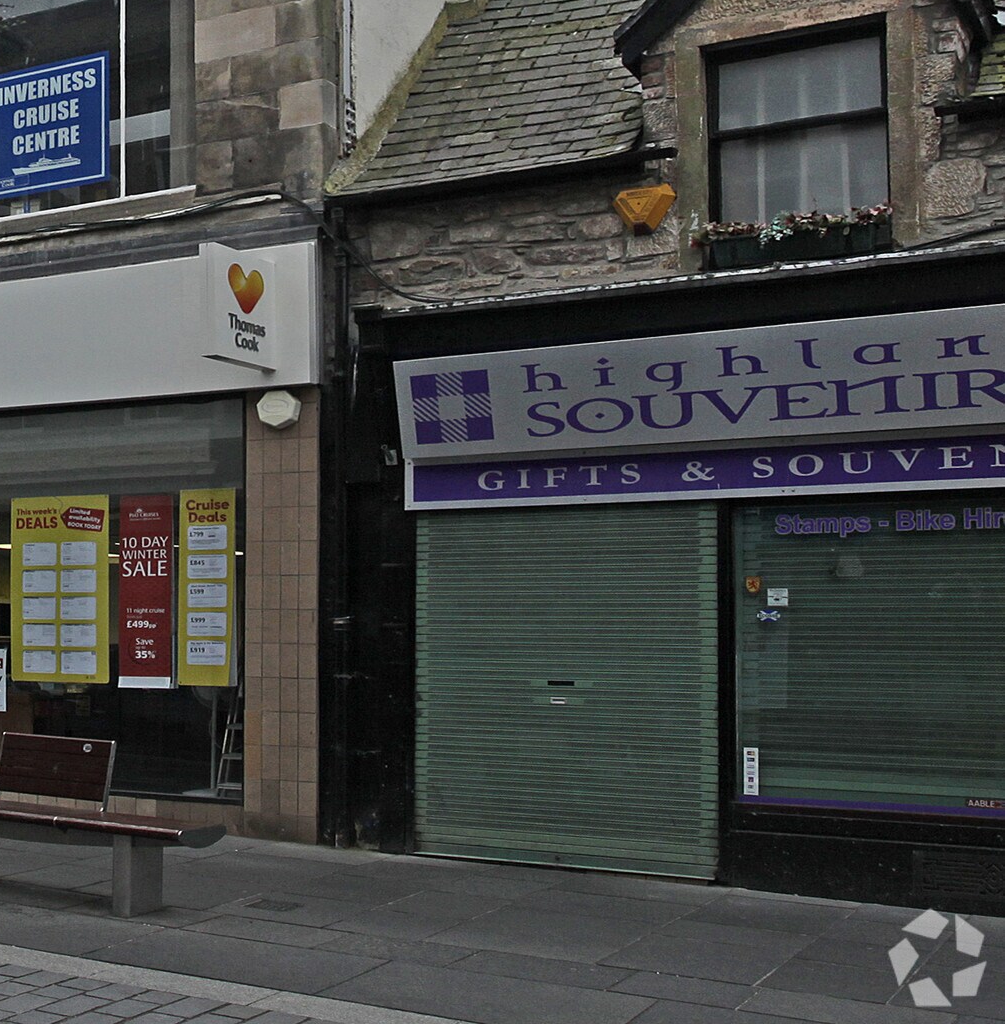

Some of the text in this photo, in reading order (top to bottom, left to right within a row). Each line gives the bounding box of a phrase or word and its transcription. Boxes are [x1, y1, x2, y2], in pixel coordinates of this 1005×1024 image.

[13, 98, 80, 129] CRUISE
[12, 125, 80, 155] CENTRE
[228, 312, 266, 337] Thomas
[235, 332, 259, 352] Cook
[526, 368, 1005, 437] SOUVENIR
[478, 462, 641, 491] GIFTS
[681, 461, 715, 482] &
[186, 499, 230, 510] Cruise
[16, 516, 58, 529] DEALS
[189, 512, 227, 523] Deals
[775, 514, 872, 538] Stamps
[895, 509, 955, 531] Bike
[963, 507, 1005, 529] Hir
[122, 536, 169, 548] 10 DAY
[122, 549, 167, 560] WINTER
[122, 560, 168, 577] SALE
[135, 637, 154, 645] Save
[135, 650, 156, 659] 35%
[968, 799, 995, 808] AABLE
